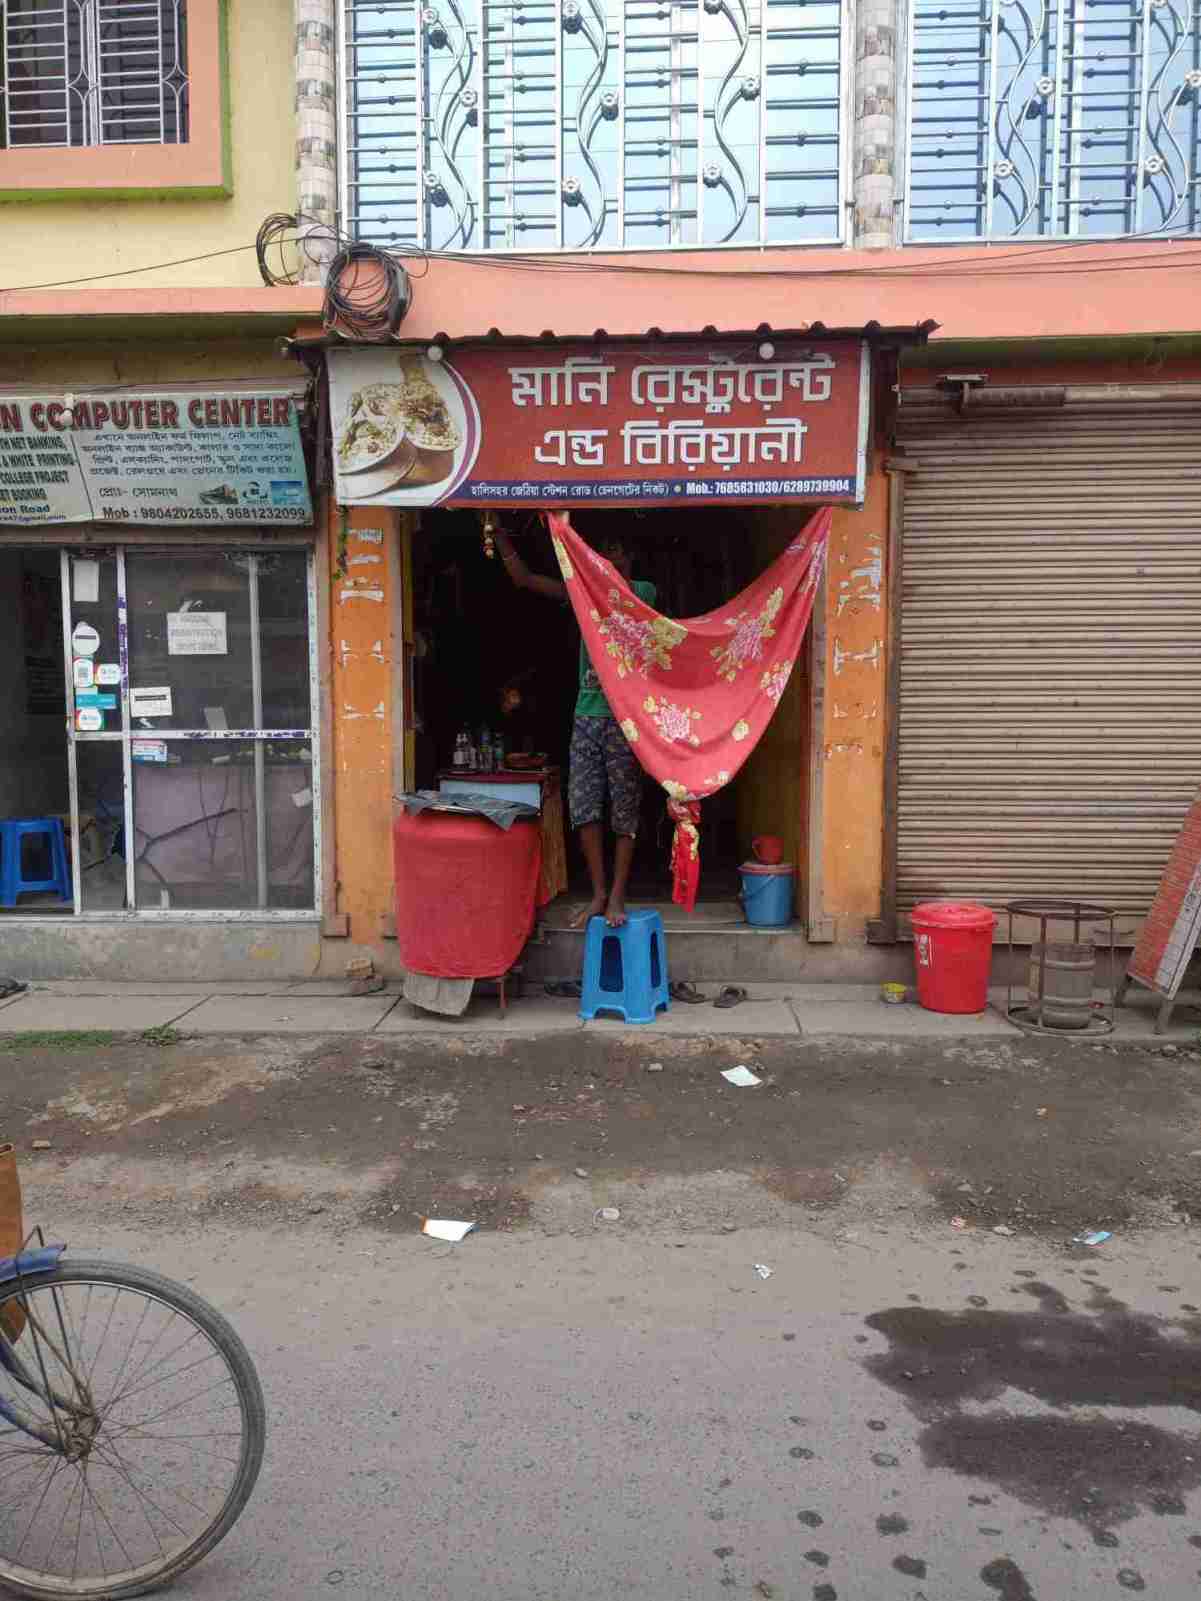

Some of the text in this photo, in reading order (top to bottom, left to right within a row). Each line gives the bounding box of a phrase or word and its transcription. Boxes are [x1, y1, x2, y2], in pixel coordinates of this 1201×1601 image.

[508, 353, 835, 413] মানি রেস্টুরেন্ট
[30, 400, 180, 432] COMPUTER
[187, 397, 290, 429] CENTER
[534, 418, 808, 472] এন্ড বিরিয়ানী
[20, 503, 50, 514] Road
